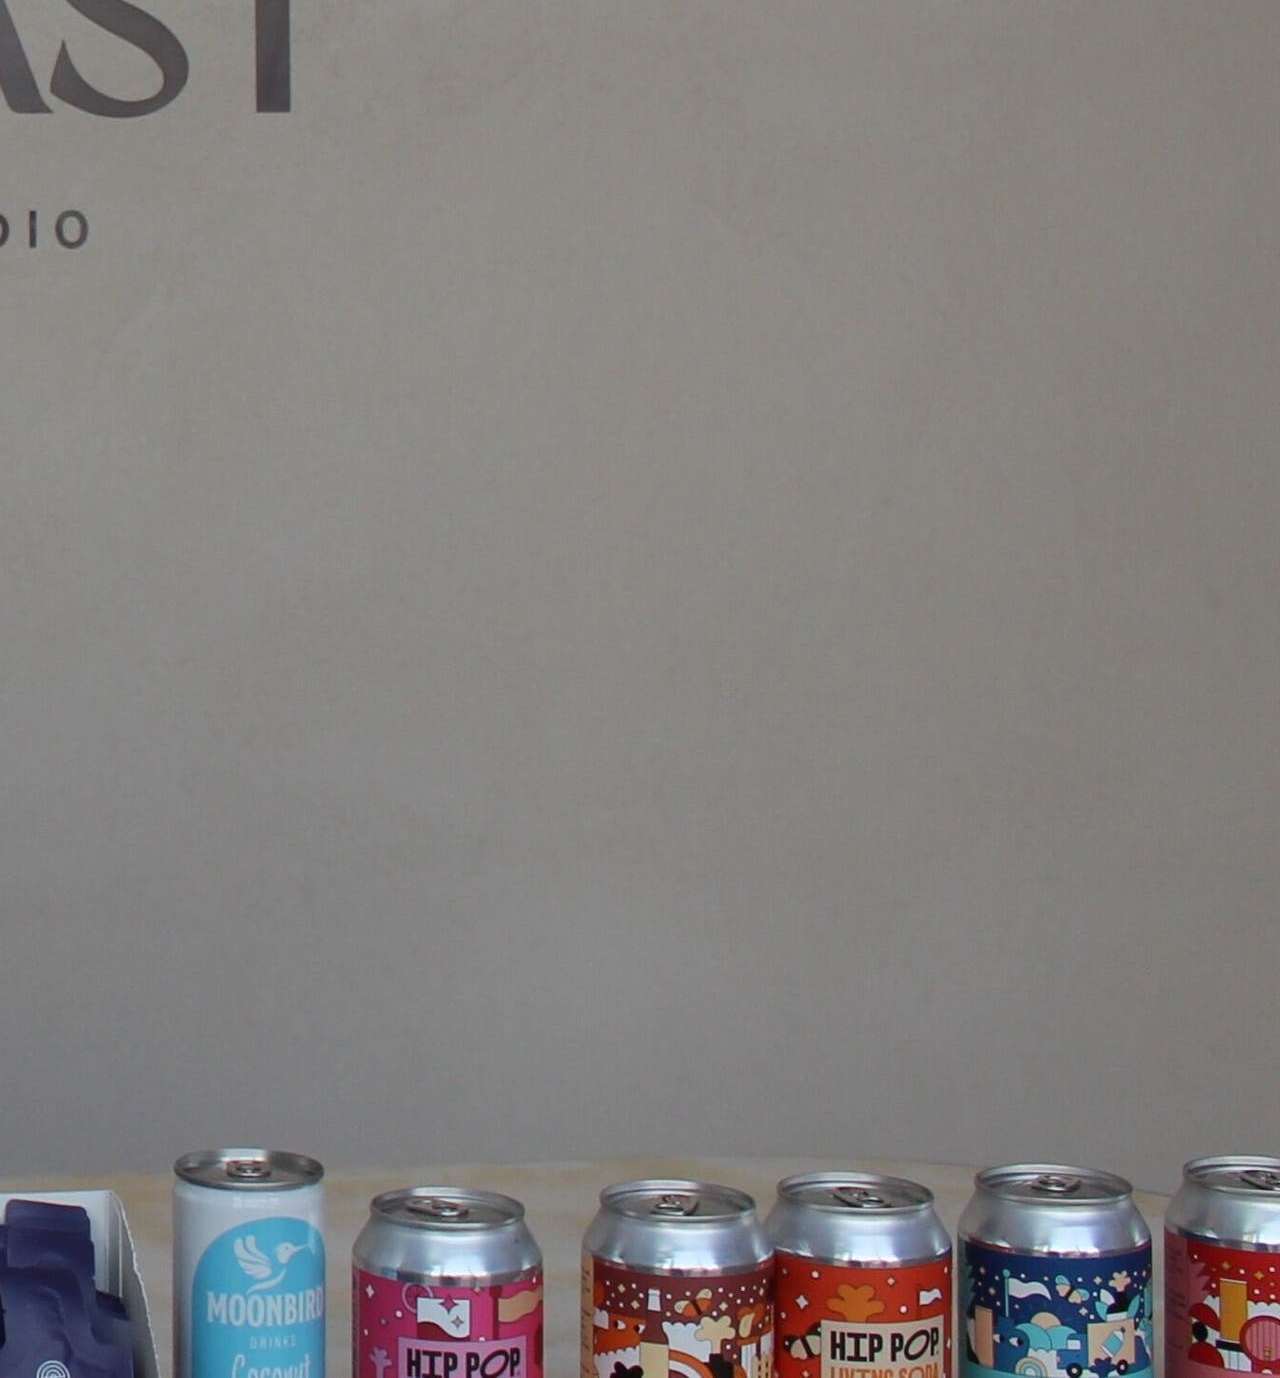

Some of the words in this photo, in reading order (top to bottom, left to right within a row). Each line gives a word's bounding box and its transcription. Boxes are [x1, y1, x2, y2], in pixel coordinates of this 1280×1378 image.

[207, 1286, 324, 1328] MOONBIRD
[830, 1330, 883, 1362] HIP
[406, 1347, 458, 1378] HIP
